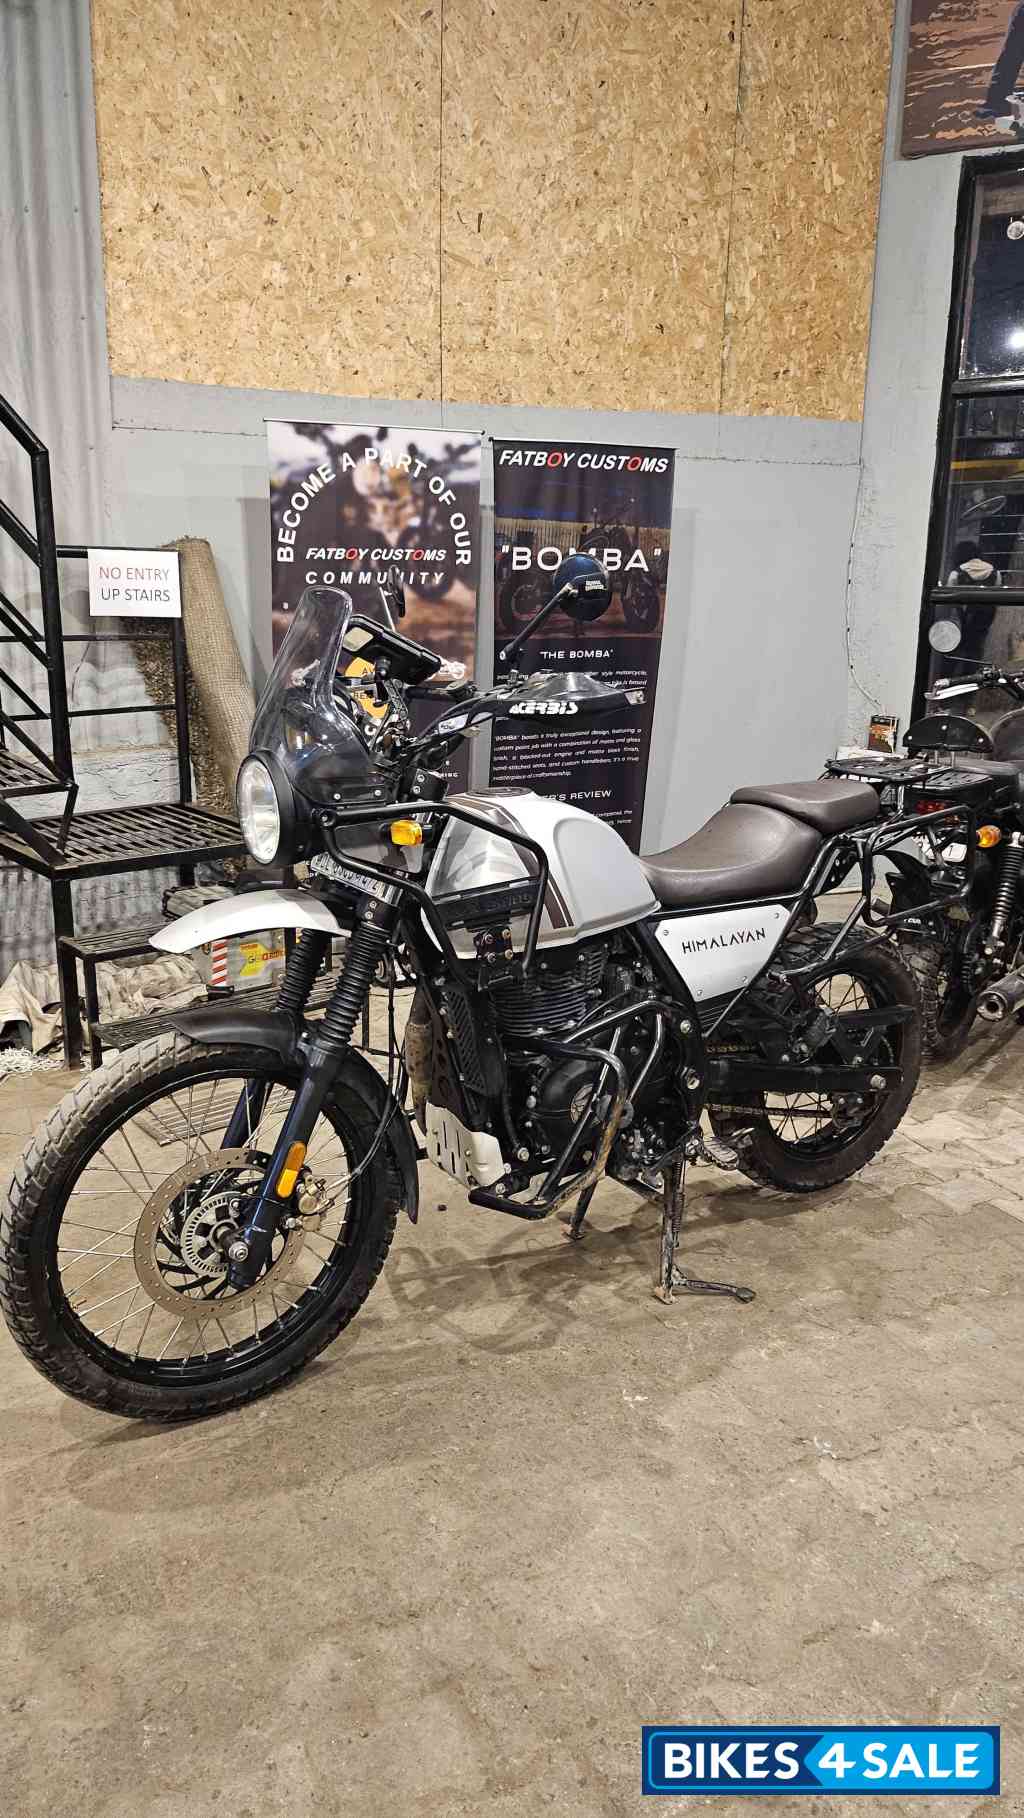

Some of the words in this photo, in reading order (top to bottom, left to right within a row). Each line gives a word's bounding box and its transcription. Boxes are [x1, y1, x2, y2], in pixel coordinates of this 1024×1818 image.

[500, 450, 576, 468] FATBOY
[577, 453, 669, 473] CUSTOMS
[277, 463, 335, 563] BECOME
[342, 452, 357, 472] A
[365, 447, 428, 478] PART
[428, 476, 457, 506] OF
[450, 512, 471, 566] OUR
[305, 547, 369, 561] FATBOY
[370, 548, 447, 561] CUSTOMS
[501, 545, 662, 572] "BOBA"
[99, 566, 122, 580] NO
[126, 567, 170, 581] ENTRY
[305, 571, 445, 585] COMMUITY
[101, 588, 121, 601] UP
[124, 588, 171, 602] STAIRS
[508, 702, 579, 715] ACERBIS
[570, 790, 612, 800] REVIEW
[681, 927, 767, 954] HIMALAYAN
